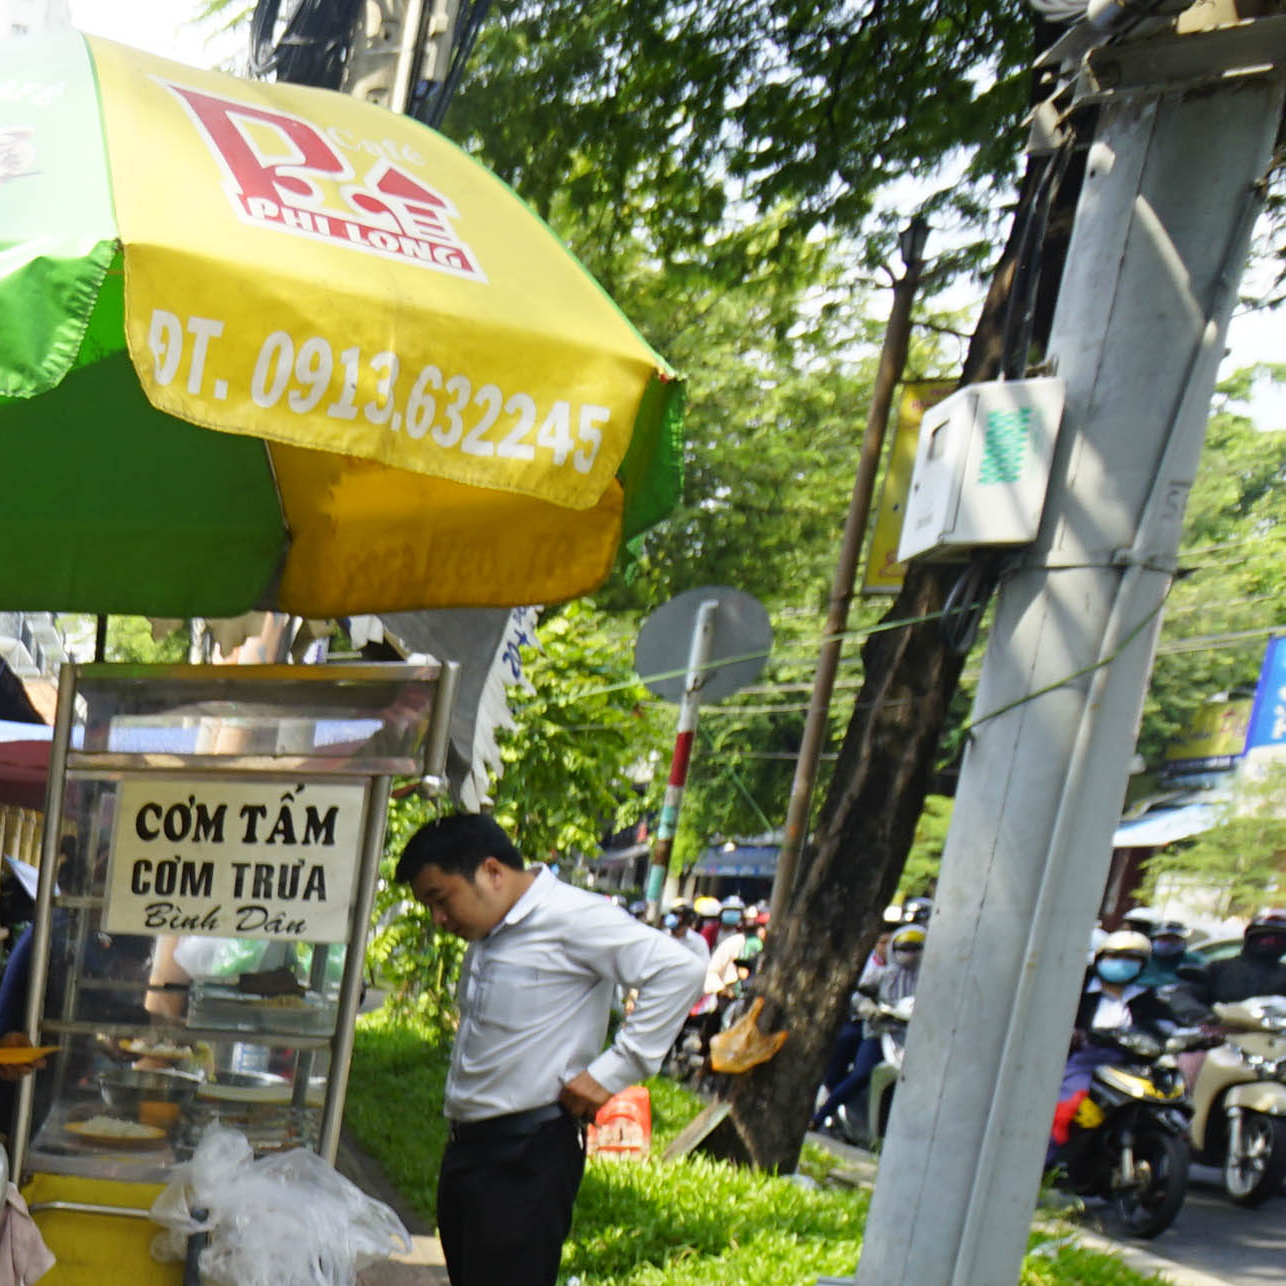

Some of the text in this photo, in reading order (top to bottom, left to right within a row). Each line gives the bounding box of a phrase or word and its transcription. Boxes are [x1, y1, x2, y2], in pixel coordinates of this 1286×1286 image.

[247, 199, 466, 271] PHI LONG
[147, 307, 611, 474] ĐT. 0913.632245
[134, 783, 340, 847] CƠM TẤM
[130, 855, 329, 903] CƠM TRƯA
[144, 901, 307, 937] Bình Dân
